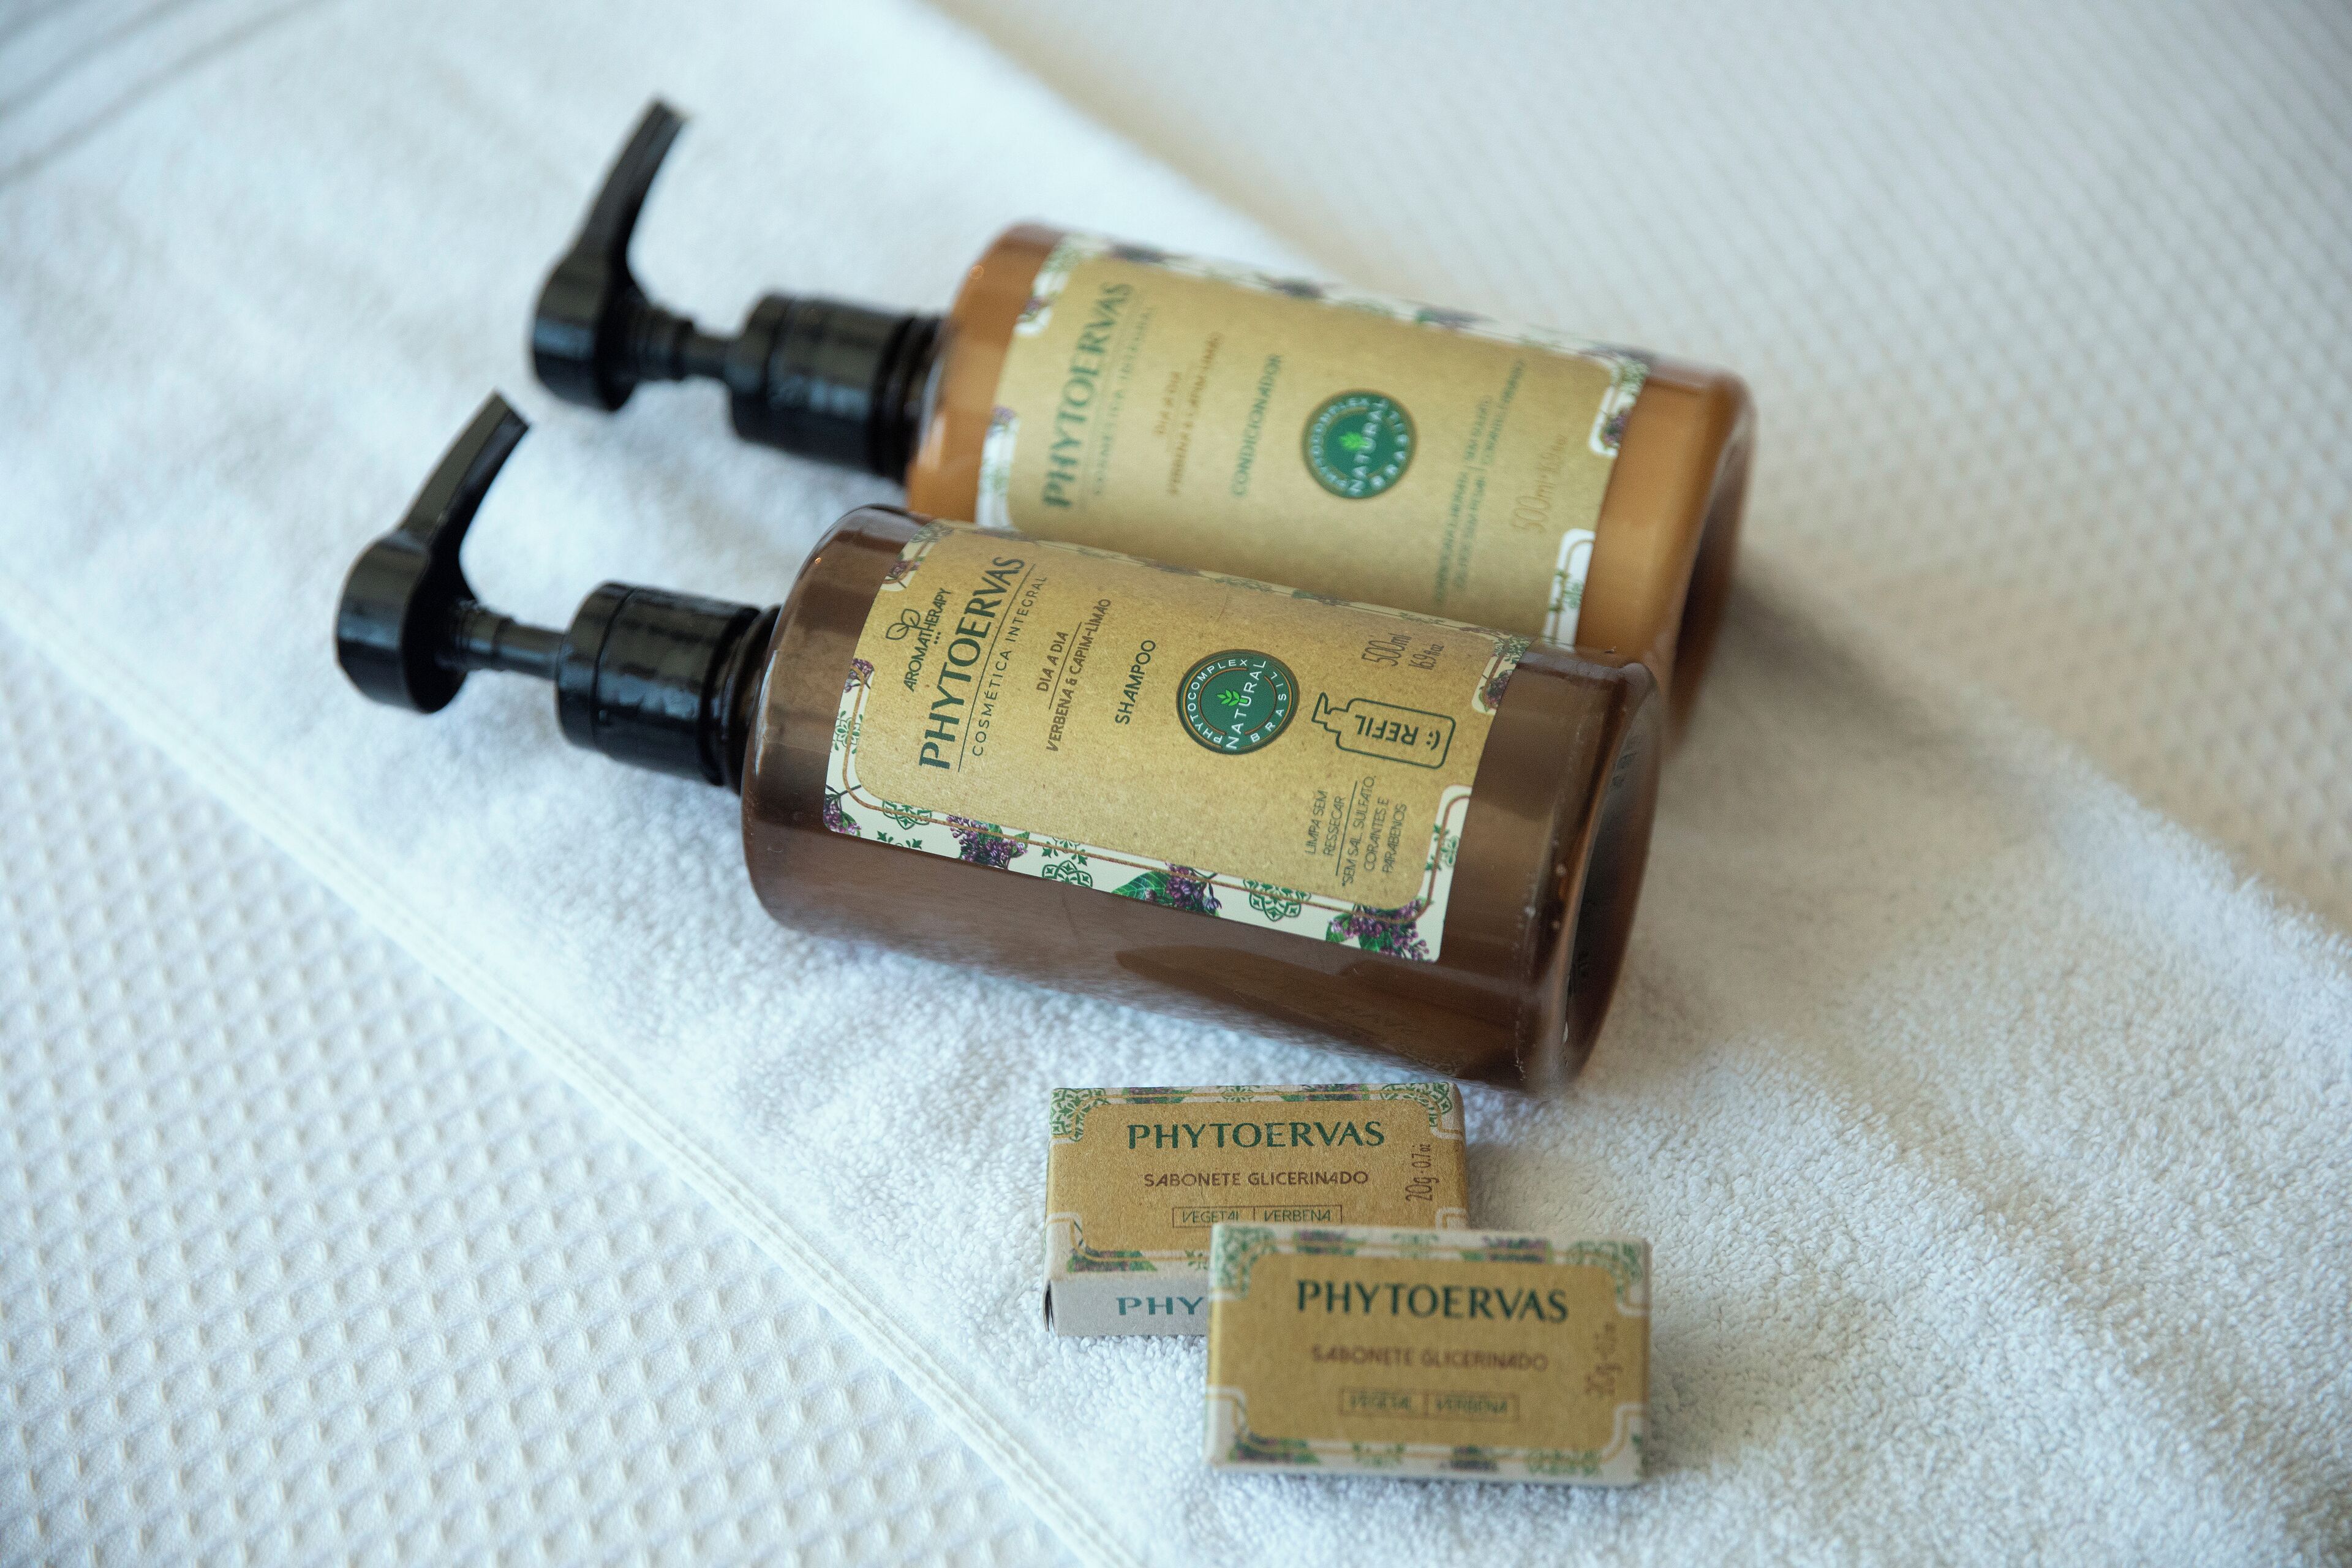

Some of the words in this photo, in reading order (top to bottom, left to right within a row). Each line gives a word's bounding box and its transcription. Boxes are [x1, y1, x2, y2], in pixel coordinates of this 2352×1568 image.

[1042, 282, 1133, 508] PHYTOERVAS
[903, 587, 951, 692] AROMATHERAPY
[919, 557, 1025, 769] PHYTOERVAS
[973, 650, 1012, 756] COSMÉTICA
[1005, 576, 1047, 642] INTEGRAL
[1047, 655, 1058, 666] A
[1050, 631, 1068, 653] DIA
[1362, 633, 1412, 666] 500ml
[1036, 668, 1054, 692] DIA
[1115, 640, 1156, 724] SHAMPOO
[1188, 660, 1248, 744] PHYTOCOMPLEX
[1226, 661, 1266, 750] NATURAL
[1250, 671, 1286, 742] BRASIL
[1046, 688, 1074, 752] VERBENA
[1066, 677, 1078, 686] &
[1355, 714, 1419, 745] REFIL
[1305, 819, 1321, 854] LIMPA
[1313, 790, 1328, 816] SEM
[1323, 796, 1346, 856] RESSECAR
[1363, 808, 1387, 872] CORANTES
[1378, 797, 1389, 806] E
[1382, 803, 1407, 873] PARABENOS
[1127, 1121, 1385, 1150] PHYTOERVAS
[1144, 1172, 1241, 1187] SABONETE
[1248, 1170, 1369, 1187] GLICERINADO
[1264, 1209, 1332, 1223] VERBENA
[1297, 1280, 1569, 1324] PHYTOERVAS
